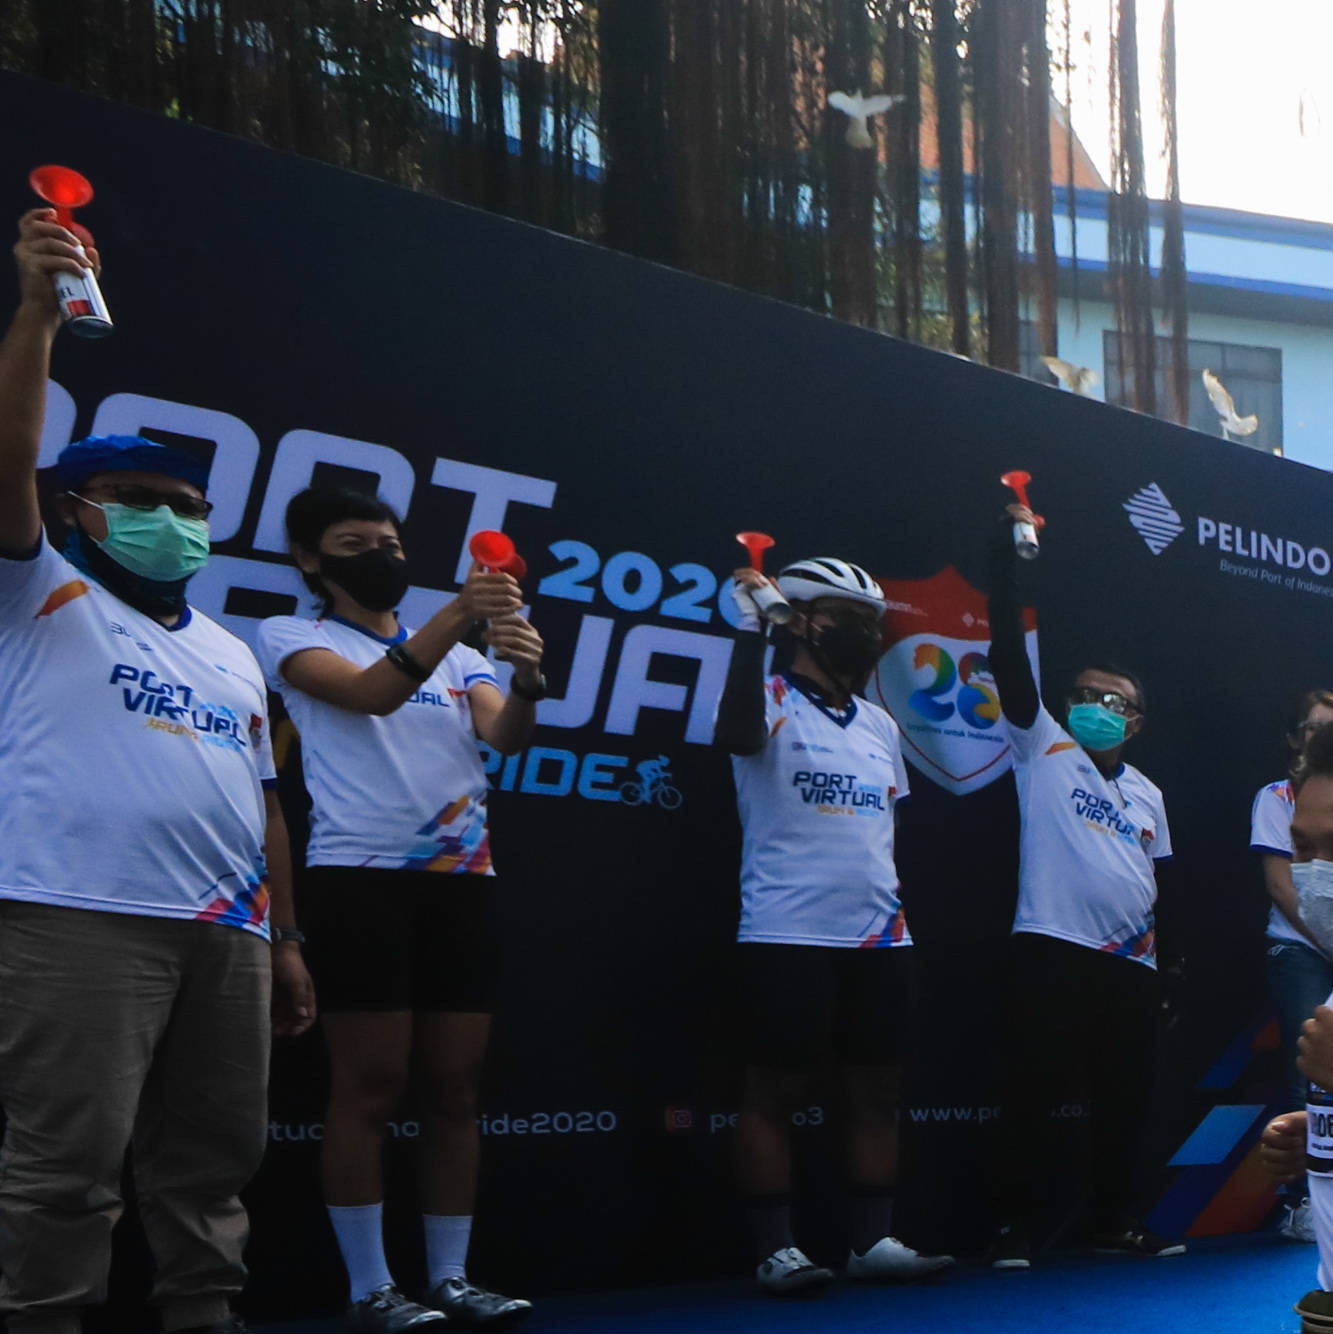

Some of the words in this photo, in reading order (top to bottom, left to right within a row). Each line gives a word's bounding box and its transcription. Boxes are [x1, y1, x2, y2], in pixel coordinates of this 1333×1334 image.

[1198, 516, 1332, 577] PELINDO
[1220, 559, 1258, 579] Beyond
[793, 771, 857, 790] PORT
[801, 787, 885, 811] VIRTUAL
